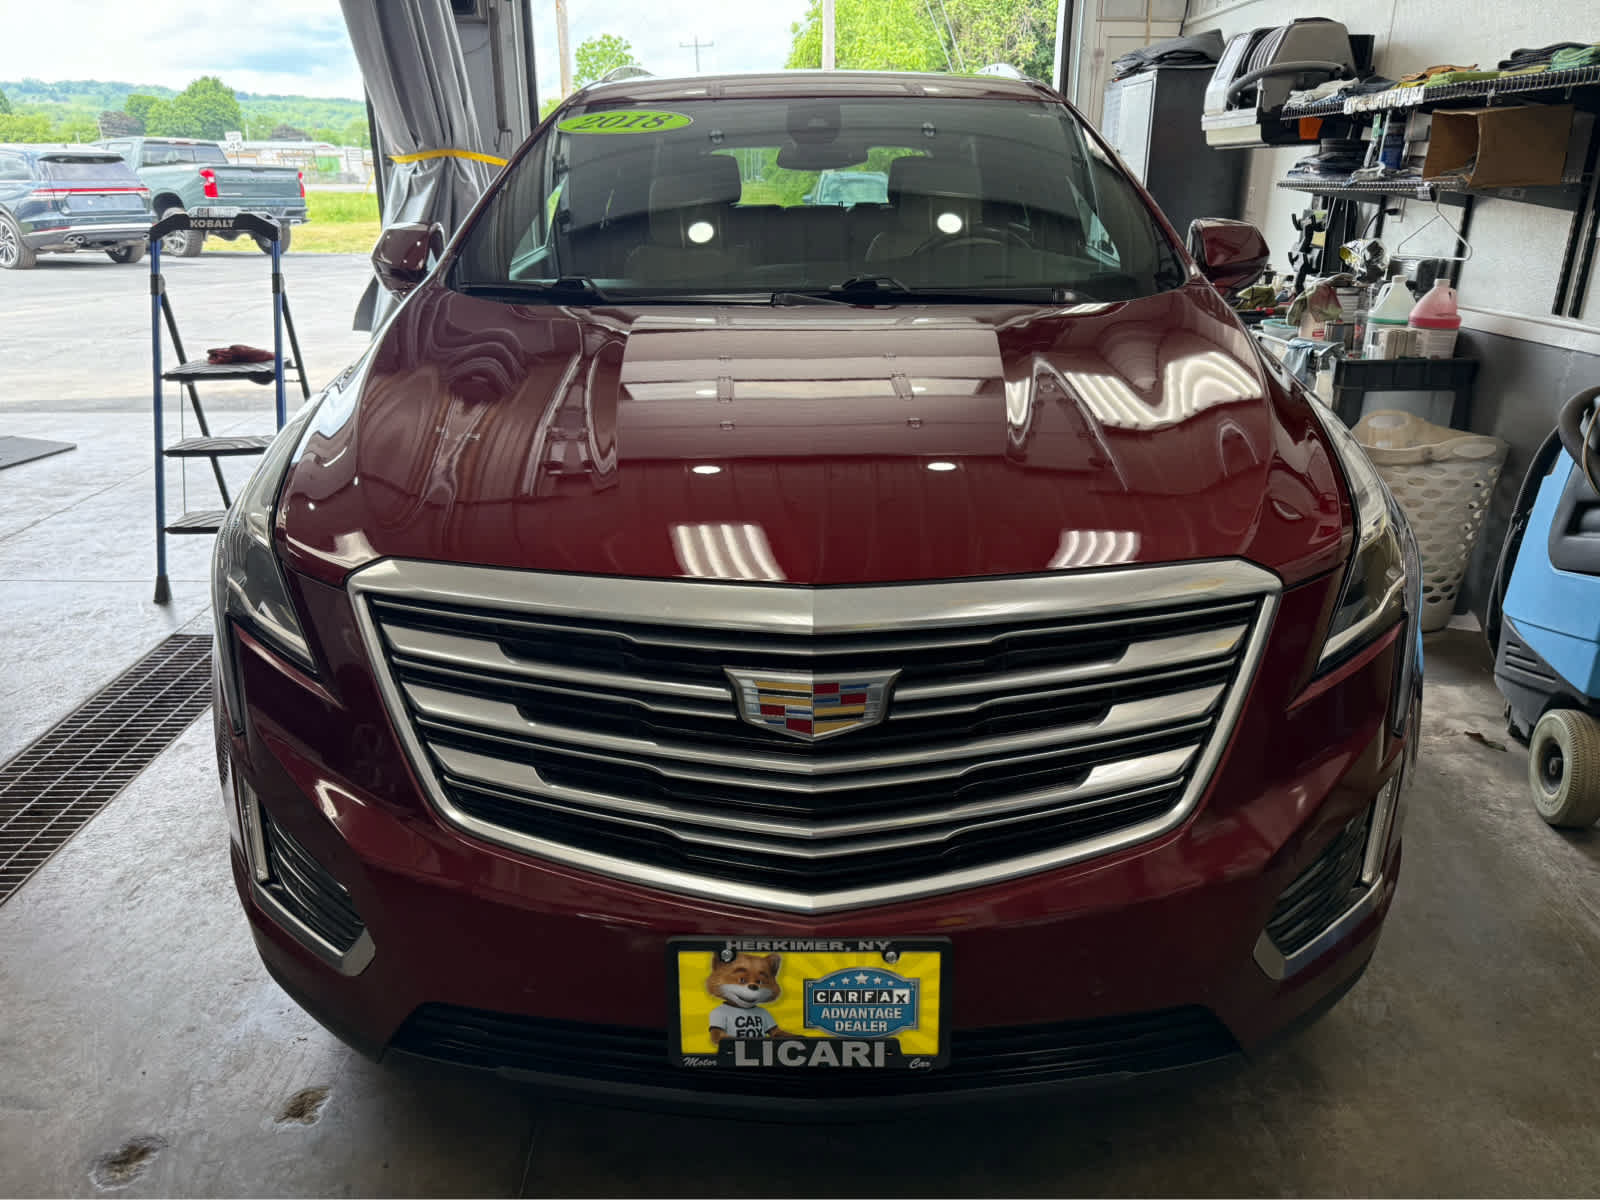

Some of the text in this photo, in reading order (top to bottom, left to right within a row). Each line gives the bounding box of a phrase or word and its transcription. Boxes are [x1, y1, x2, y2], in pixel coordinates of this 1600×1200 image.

[572, 114, 674, 129] 2018
[189, 219, 235, 228] KOBALT
[725, 939, 892, 951] HERKIMER, NY
[815, 990, 907, 1004] CARFAX
[820, 1007, 902, 1019] ADVANTAGE
[735, 1015, 763, 1028] CAR
[835, 1020, 888, 1032] DEALER
[735, 1040, 886, 1068] LICARI
[682, 1056, 718, 1067] Motor
